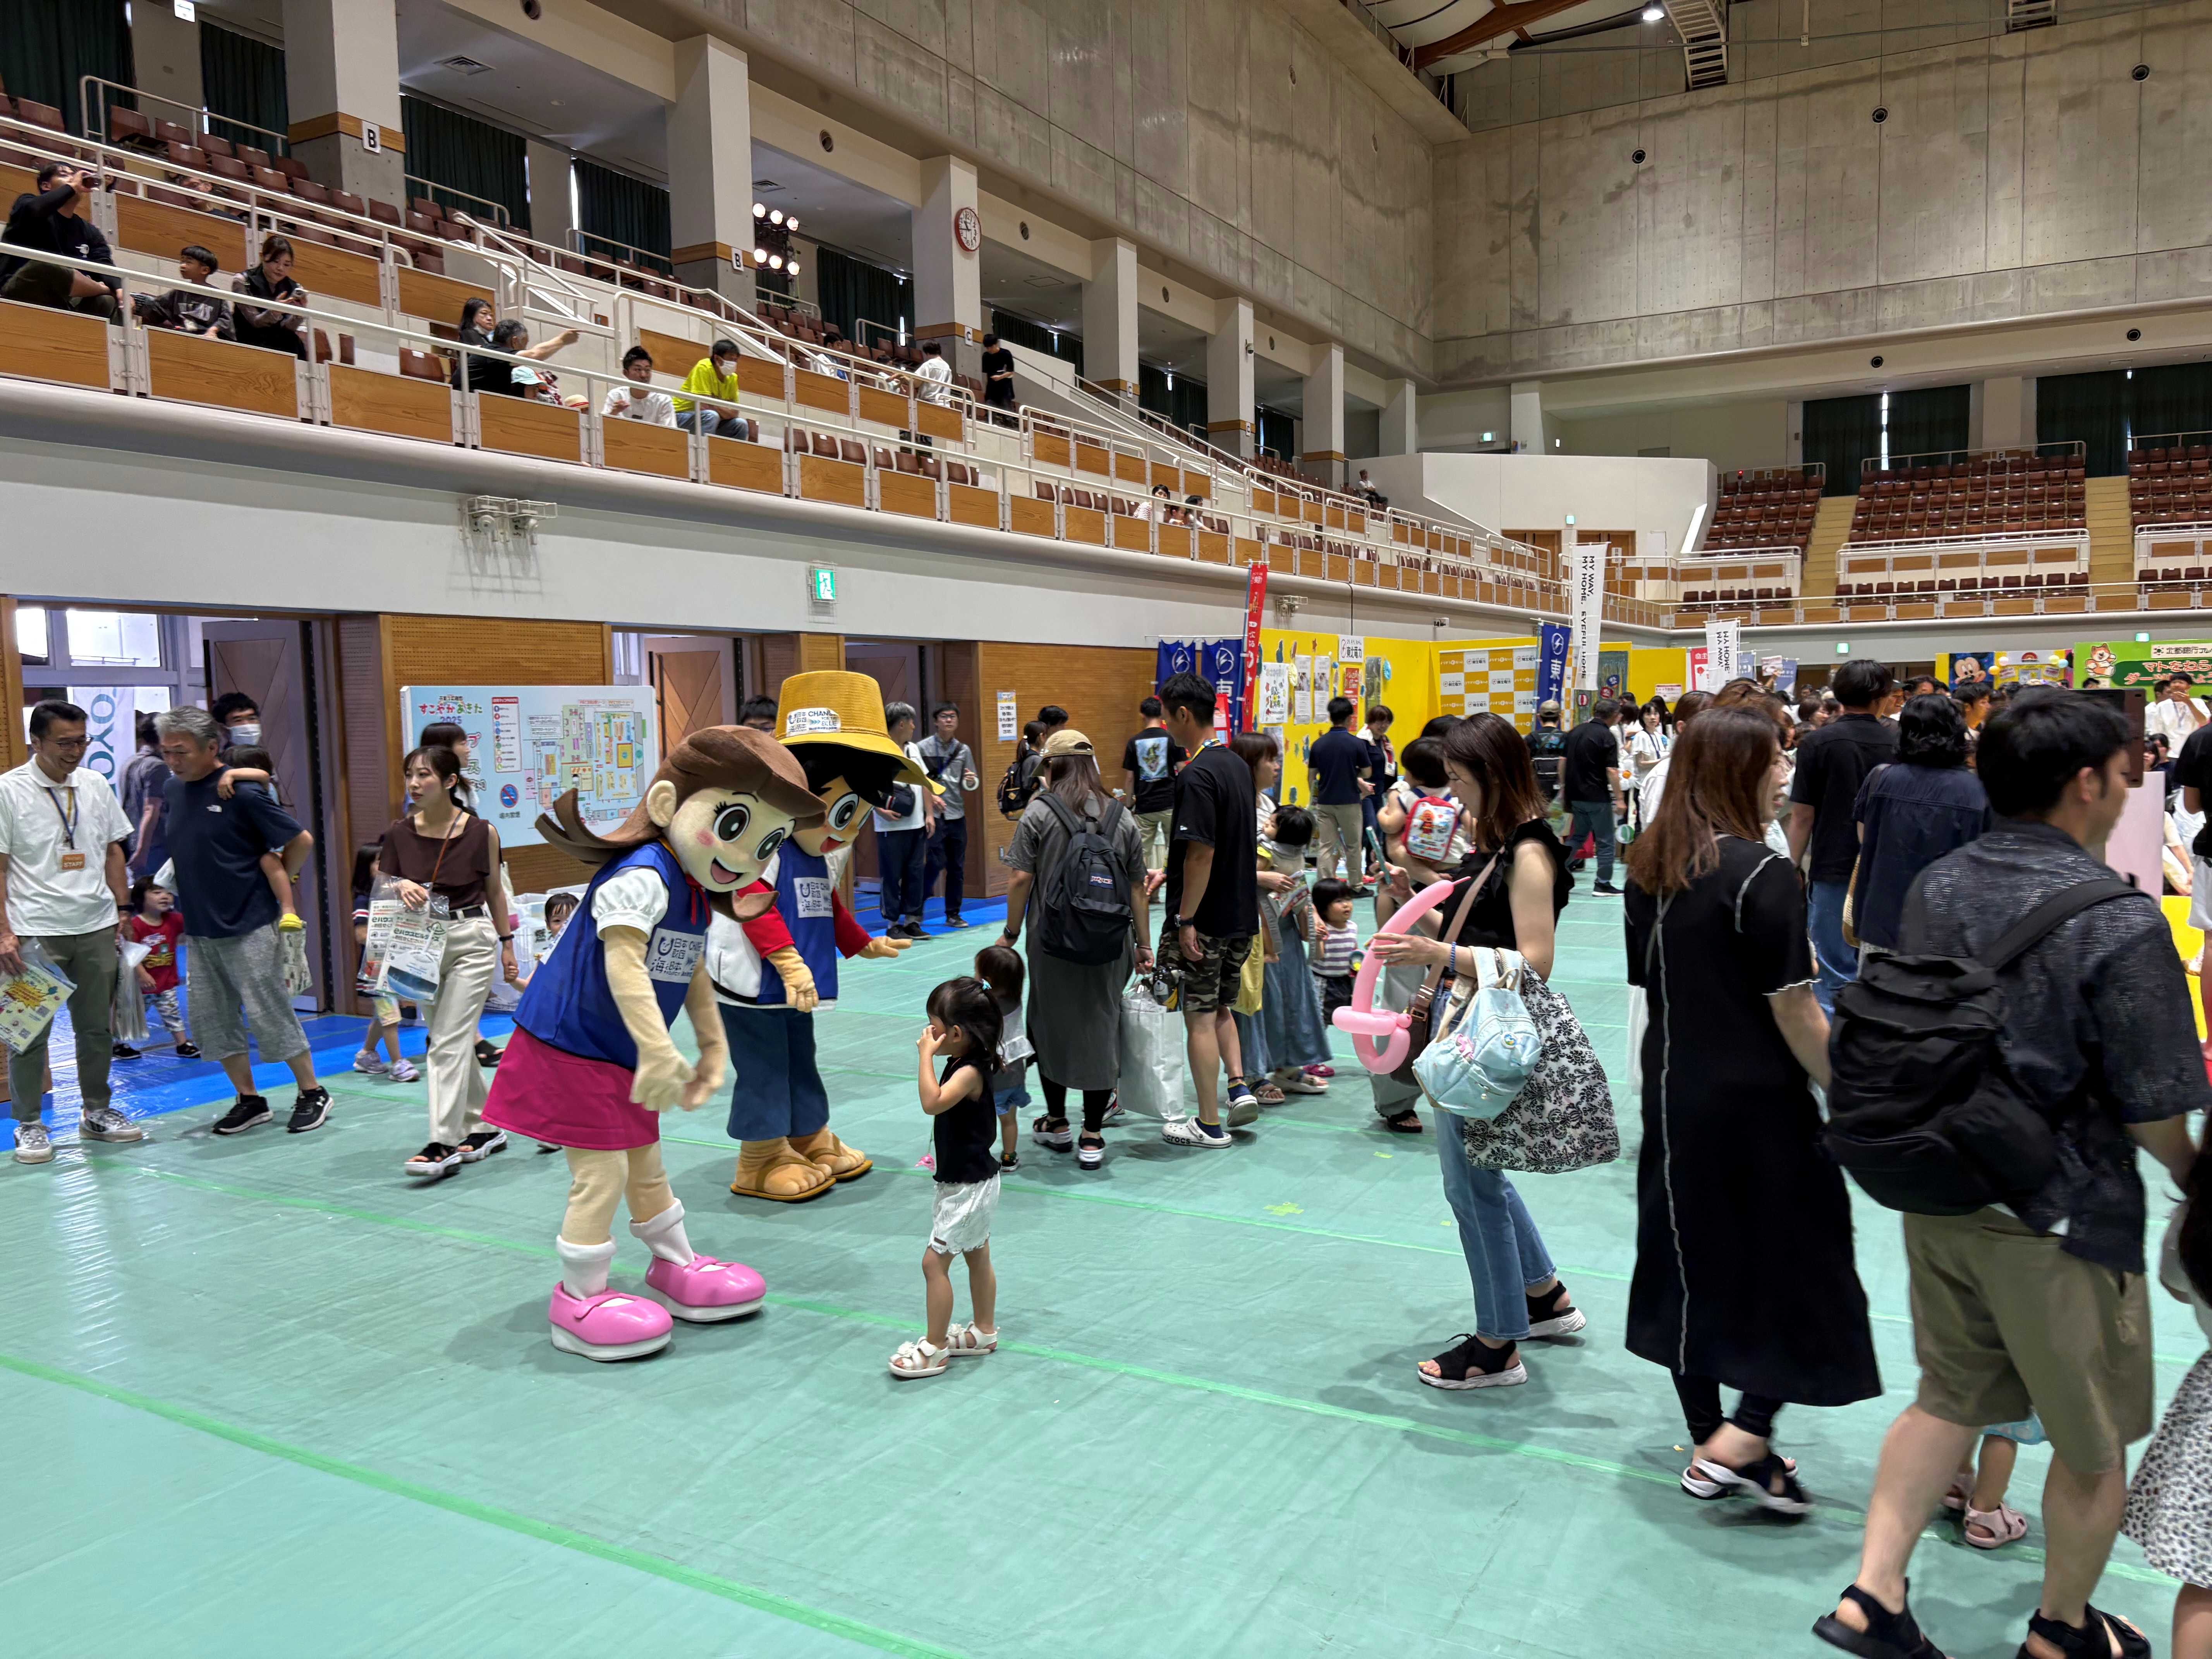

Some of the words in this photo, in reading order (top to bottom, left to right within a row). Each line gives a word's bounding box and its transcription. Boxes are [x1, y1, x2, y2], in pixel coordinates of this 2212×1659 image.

[368, 129, 376, 148] B
[735, 253, 741, 267] B
[967, 331, 971, 340] C
[1582, 556, 1588, 570] MY
[1589, 556, 1595, 570] MY
[2142, 659, 2212, 673] マトをねら
[419, 703, 483, 714] すこやかあきた
